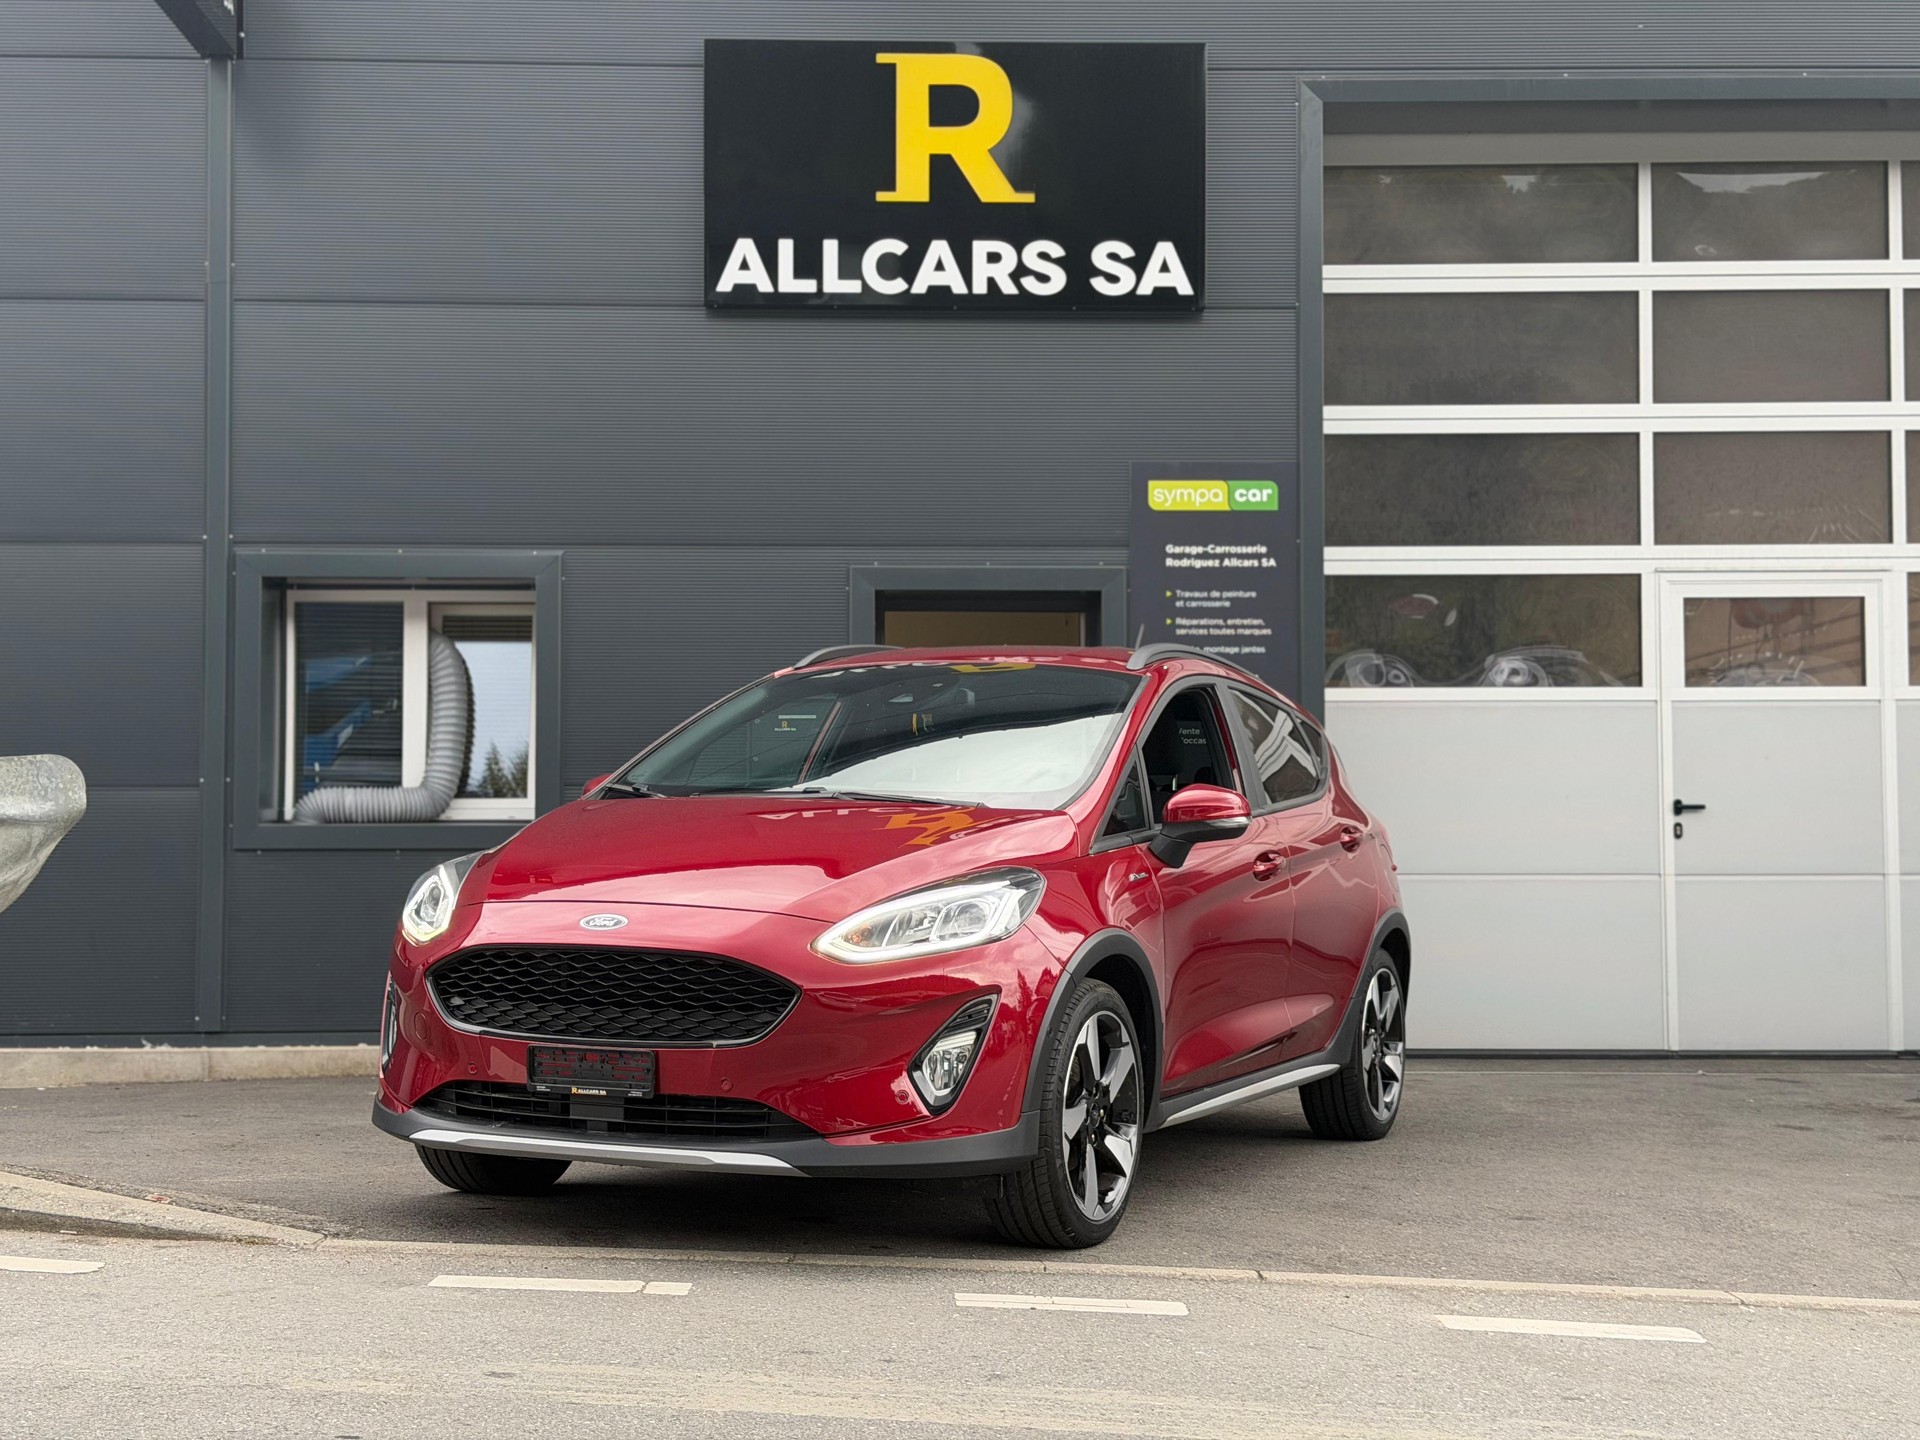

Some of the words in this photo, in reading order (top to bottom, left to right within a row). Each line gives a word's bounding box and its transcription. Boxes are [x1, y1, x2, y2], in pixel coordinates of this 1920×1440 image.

[875, 52, 1036, 204] R
[715, 237, 1068, 296] ALLCARS
[1089, 240, 1195, 297] SA
[1153, 488, 1223, 507] sympa
[1234, 487, 1273, 502] car
[1165, 544, 1267, 555] Garage-Carrosserie
[1165, 557, 1220, 568] Rodriguez
[1222, 558, 1259, 567] Allcars
[1261, 558, 1277, 567] SA
[1175, 590, 1208, 598] Travaux
[1209, 590, 1221, 598] de
[1222, 590, 1257, 599] peinture
[1175, 600, 1184, 608] et
[1185, 600, 1231, 608] carrosserie
[1237, 628, 1272, 637] marques
[1203, 646, 1240, 655] montage
[1241, 645, 1266, 655] jantes
[588, 917, 618, 927] Ford
